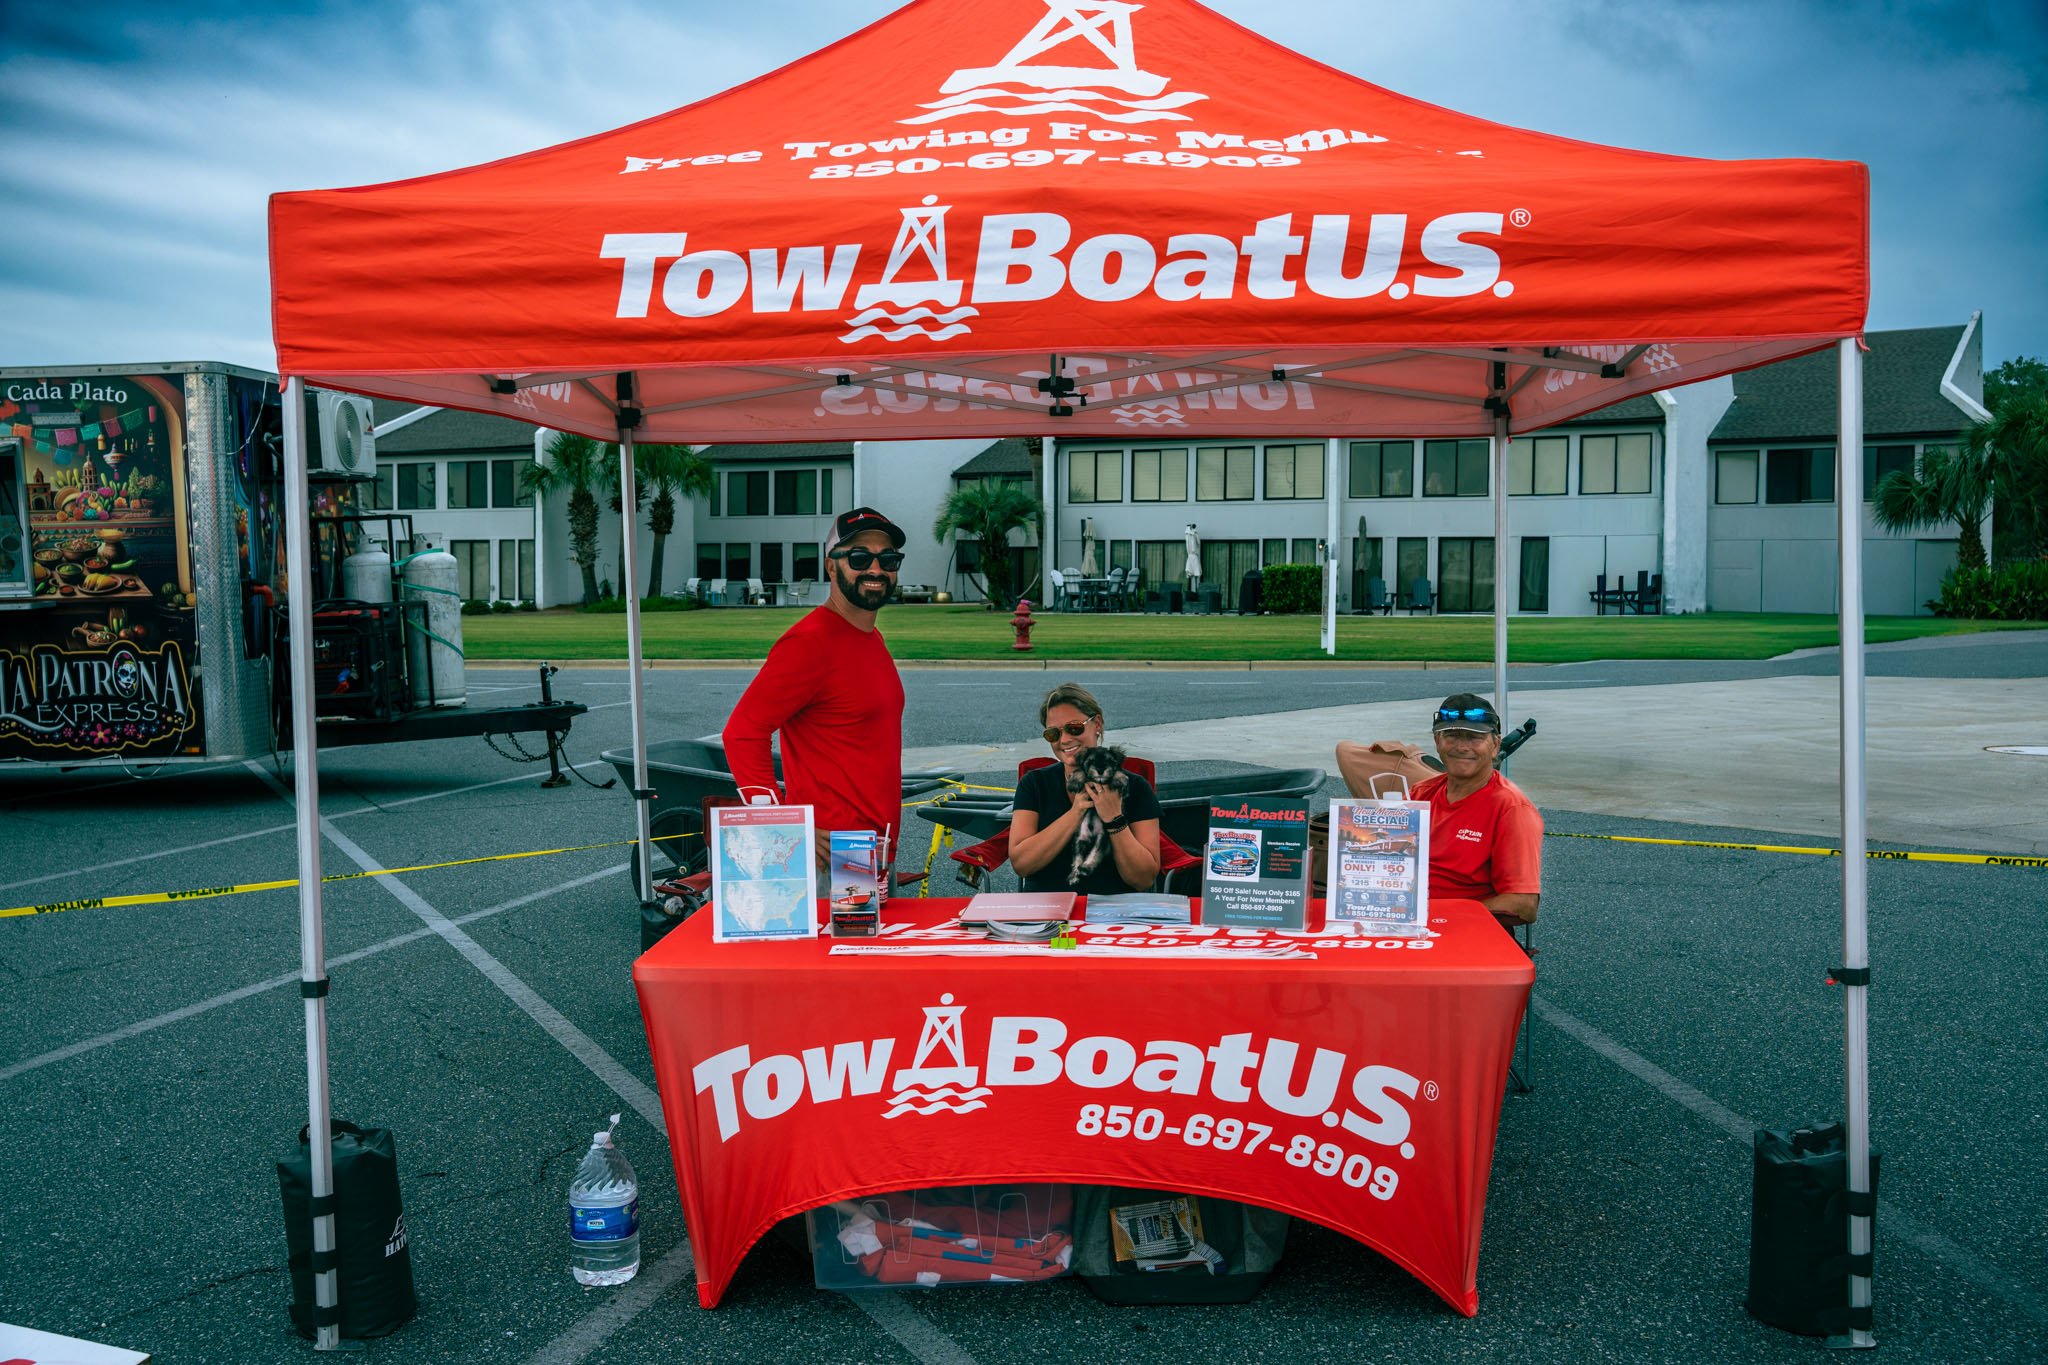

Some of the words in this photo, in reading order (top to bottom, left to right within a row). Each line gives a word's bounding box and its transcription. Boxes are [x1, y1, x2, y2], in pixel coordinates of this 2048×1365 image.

[619, 155, 763, 175] Free
[784, 127, 1030, 160] Towing
[1049, 122, 1158, 144] For
[809, 148, 1302, 180] 850-697-8909
[600, 232, 862, 318] Tow
[7, 382, 63, 402] Cada
[69, 383, 128, 404] Plato
[37, 702, 158, 727] EXPRESS
[1344, 863, 1375, 872] ONLY!
[1383, 864, 1405, 873] $50
[1265, 897, 1295, 905] Members
[1268, 889, 1284, 897] Only
[1240, 904, 1283, 912] 850-697-8909
[1086, 936, 1435, 950] 850-697-8909
[692, 1037, 896, 1144] Tow
[1075, 1103, 1400, 1201] 850-697-8909
